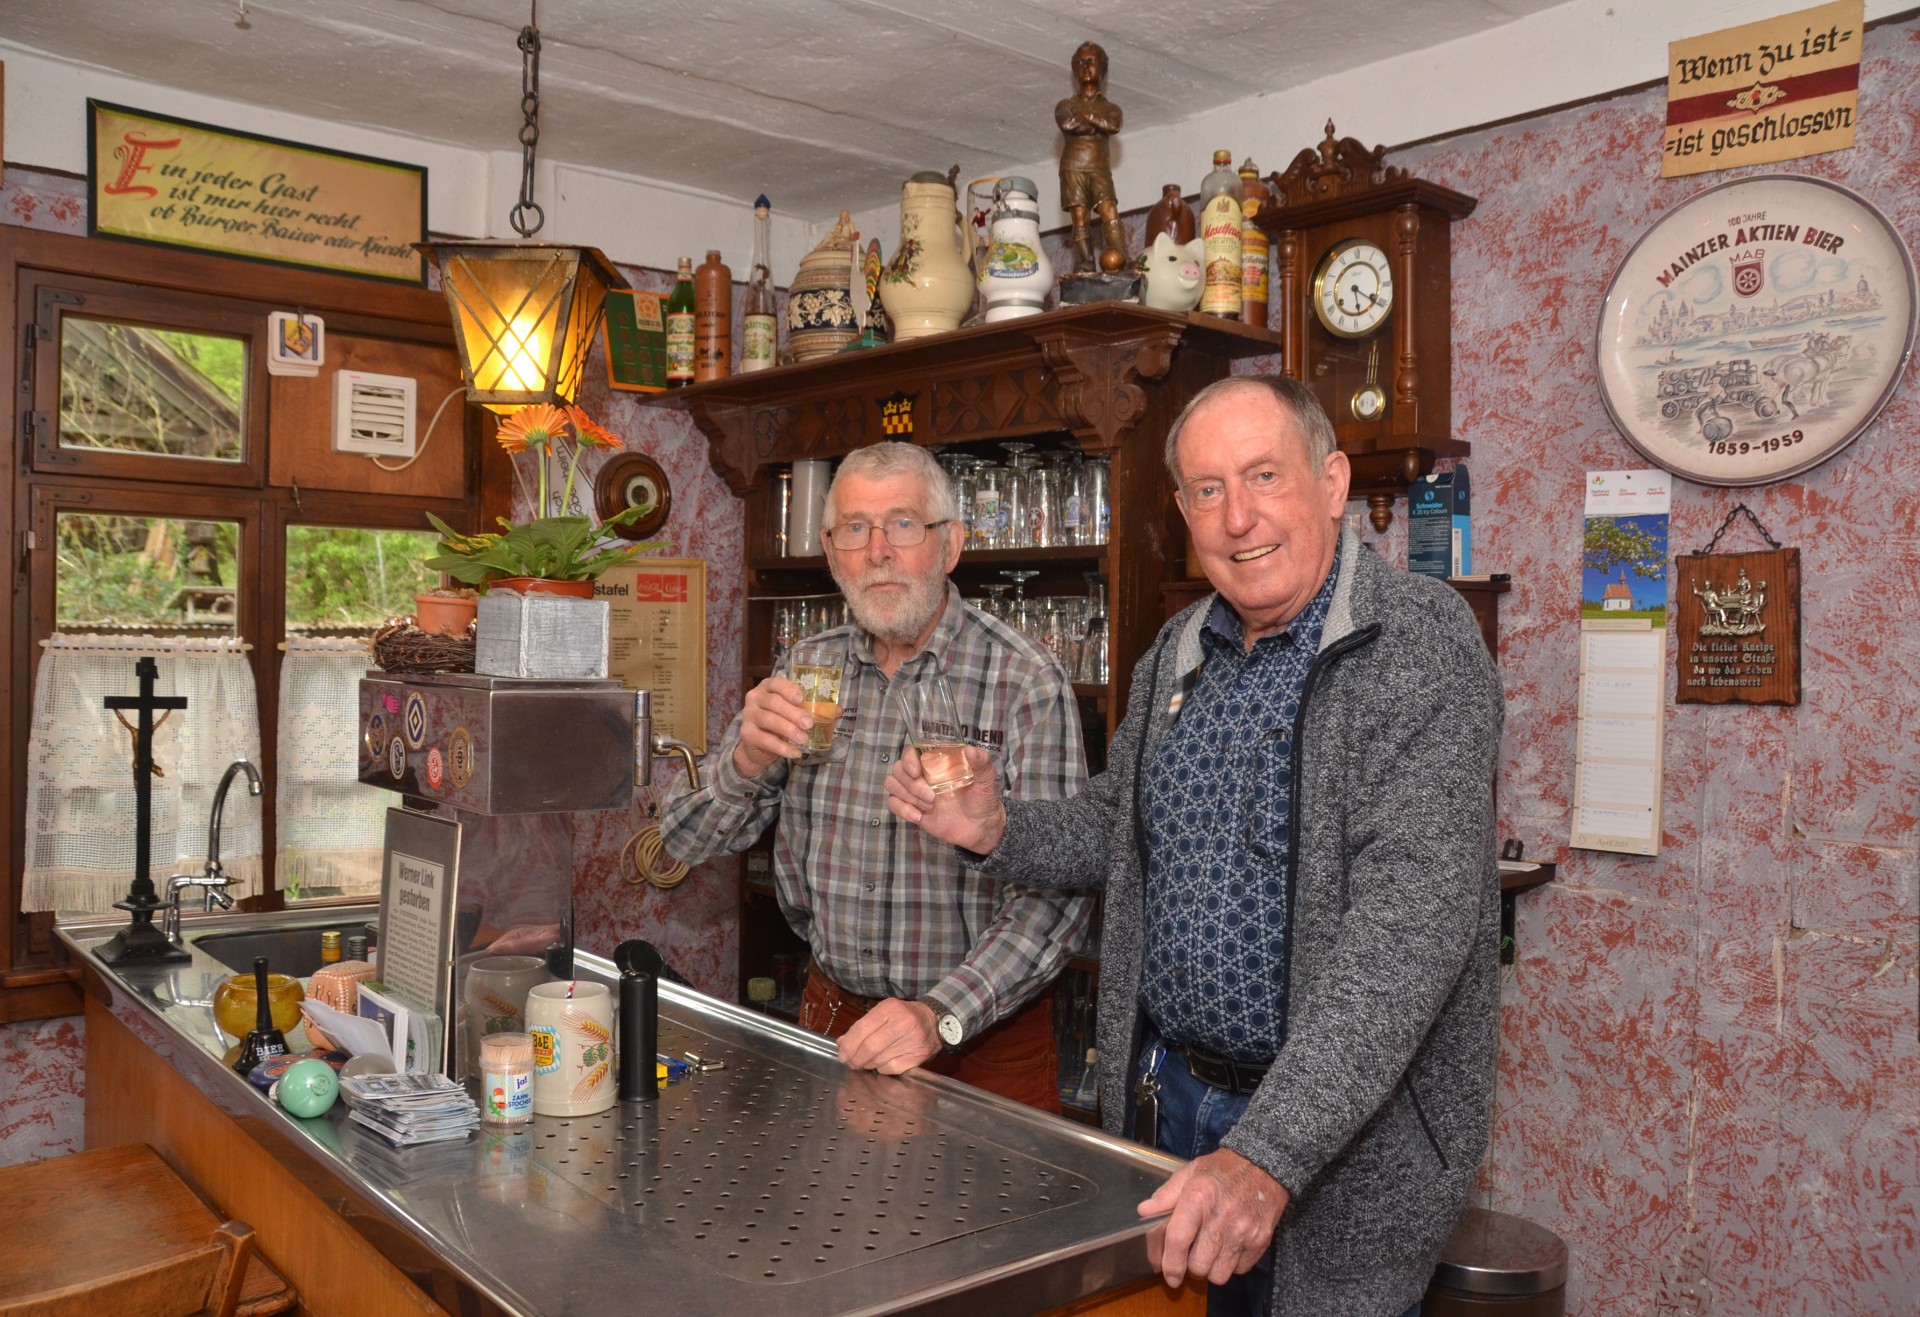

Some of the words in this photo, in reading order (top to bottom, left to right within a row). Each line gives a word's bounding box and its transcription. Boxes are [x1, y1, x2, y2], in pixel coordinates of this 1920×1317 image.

[1676, 53, 1753, 85] Wenn
[1711, 106, 1852, 157] geschlossen
[187, 161, 252, 191] jeder
[259, 173, 320, 203] Gast
[1727, 215, 1741, 227] 100
[1742, 211, 1767, 223] JAHRE
[1656, 234, 1730, 288] MAINZER
[1734, 224, 1799, 247] AKTIEN
[1802, 227, 1845, 255] BIER
[1728, 249, 1766, 265] MAB
[1416, 502, 1443, 510] Schneider
[1692, 642, 1707, 652] Die
[1690, 654, 1699, 663] in
[1703, 655, 1738, 663] unserer
[1724, 665, 1741, 674] das
[1710, 677, 1761, 686] lebenswert
[399, 862, 421, 884] Werner
[421, 868, 434, 889] Link
[400, 888, 430, 912] gestorben
[256, 1044, 285, 1056] BIER
[516, 1076, 528, 1090] ja!
